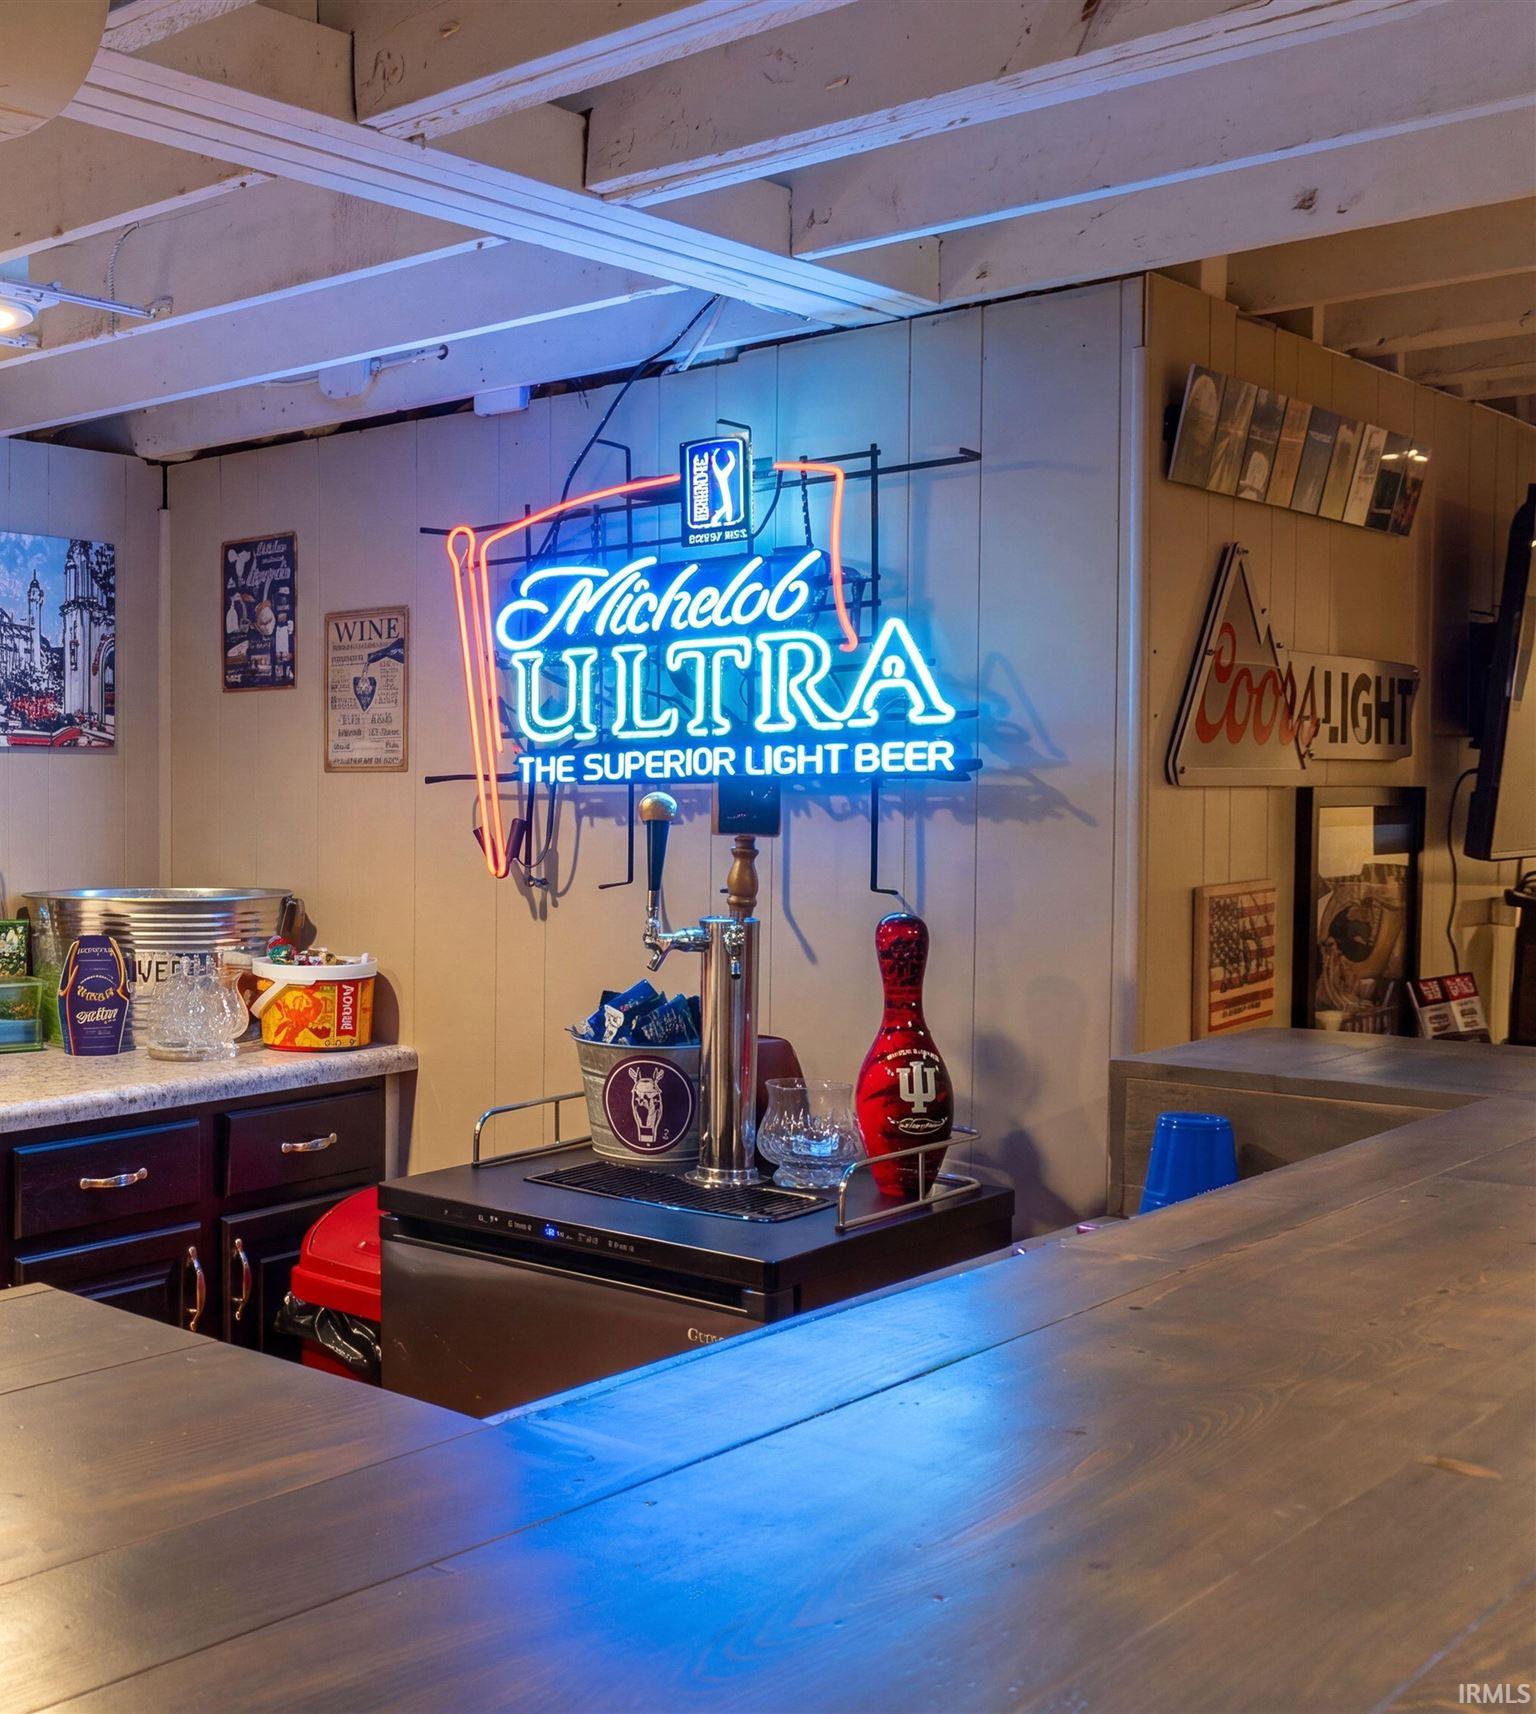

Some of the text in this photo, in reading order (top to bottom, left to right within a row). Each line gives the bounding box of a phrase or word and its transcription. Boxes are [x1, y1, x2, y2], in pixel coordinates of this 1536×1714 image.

[334, 617, 400, 643] WINE
[496, 550, 822, 650] Michelob
[511, 616, 957, 742] ULTRA
[1321, 670, 1420, 745] LIGHT
[519, 740, 956, 784] THE SUPERIOR LIGHT BEER
